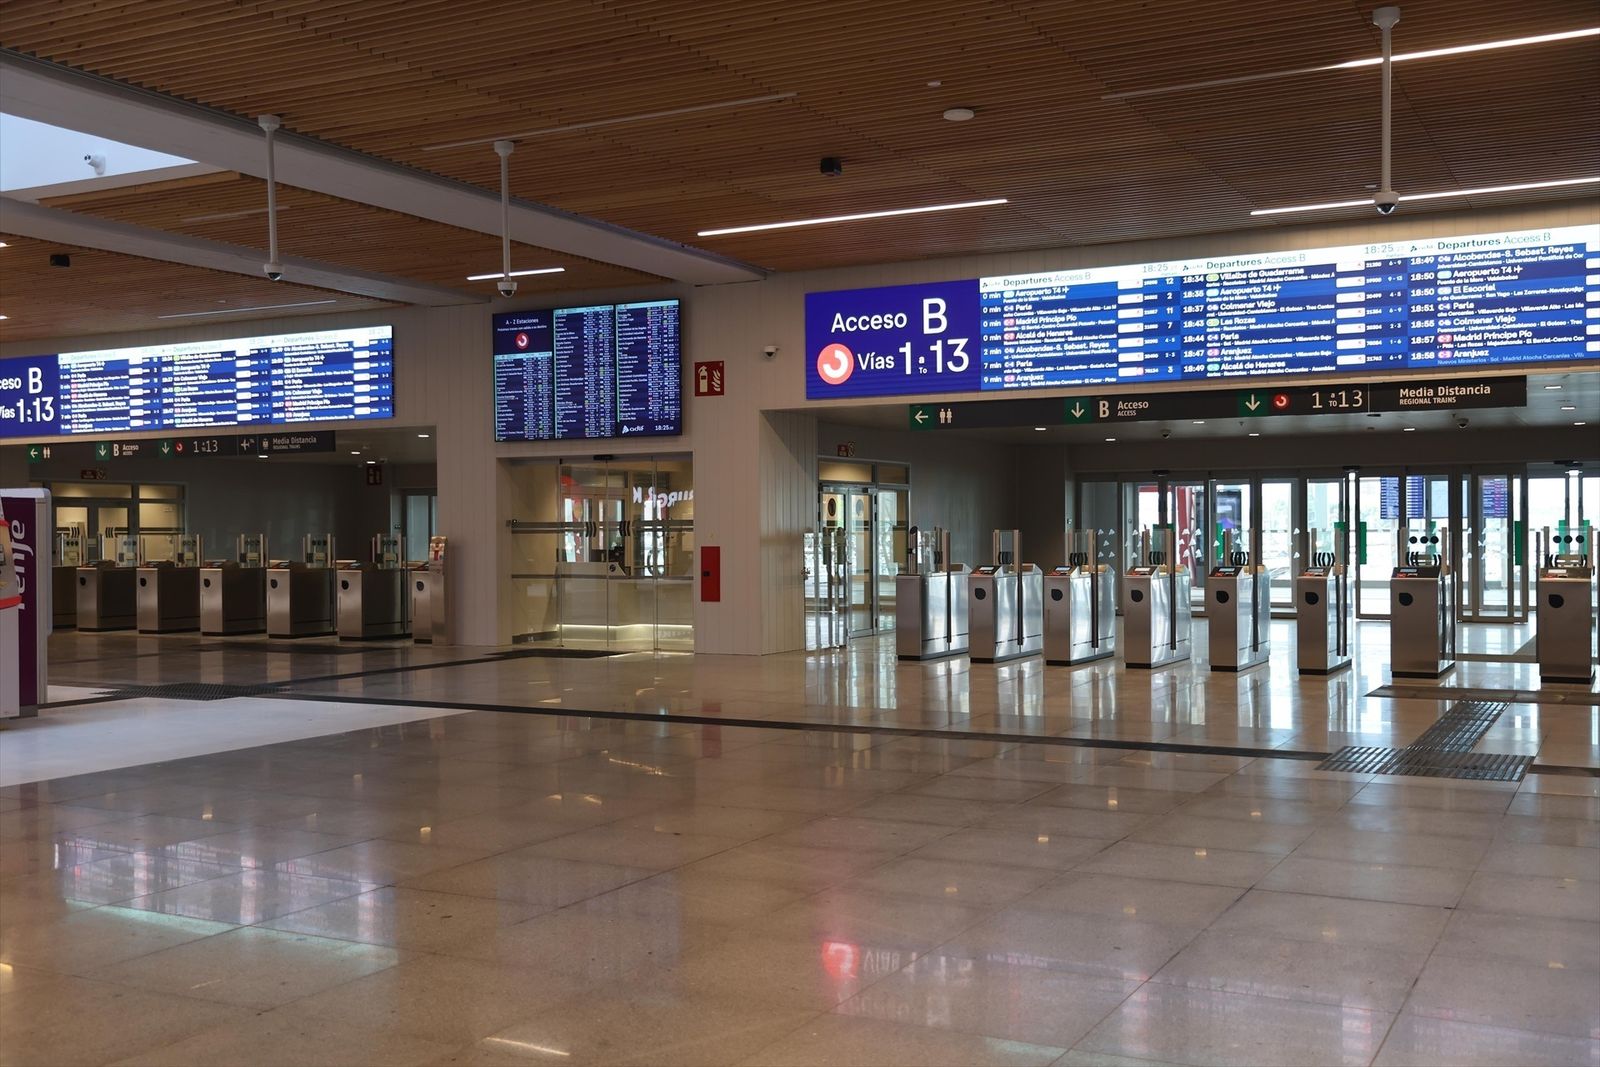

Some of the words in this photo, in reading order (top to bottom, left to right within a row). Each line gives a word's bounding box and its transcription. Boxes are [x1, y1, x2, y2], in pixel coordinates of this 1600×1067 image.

[1437, 237, 1500, 251] Departures
[1504, 233, 1540, 244] Access
[1543, 232, 1550, 241] B
[1206, 257, 1261, 270] Departures
[1264, 254, 1296, 264] Access
[1299, 253, 1305, 261] B
[1364, 244, 1393, 254] 18:25
[1410, 256, 1434, 264] 18:49
[1548, 244, 1573, 255] Reyes
[1003, 275, 1052, 287] Departures
[1054, 273, 1083, 281] Access
[1143, 263, 1168, 272] 18:25
[1182, 275, 1203, 283] 18:34
[1220, 272, 1246, 280] Villalba
[1259, 267, 1303, 277] Guadarrama
[1410, 272, 1434, 280] 18:50
[1453, 266, 1499, 278] Aeropuerto
[1015, 288, 1051, 298] Aeropuerto
[1220, 286, 1260, 296] Aeropuerto
[1410, 288, 1434, 296] 18:50
[1462, 283, 1495, 292] Escorial
[1220, 301, 1255, 310] Colmenar
[1257, 300, 1275, 308] Viejo
[1411, 304, 1434, 312] 18:51
[1453, 301, 1473, 309] Parla
[831, 313, 907, 333] Acceso
[923, 298, 947, 334] B
[1234, 316, 1255, 324] Rozas
[1411, 319, 1434, 328] 18:55
[1453, 316, 1493, 325] Colmenar
[1495, 314, 1515, 324] Viejo
[1220, 332, 1238, 340] Parla
[1411, 335, 1434, 344] 18:57
[1453, 332, 1481, 341] Madrid
[1483, 330, 1517, 341] Príncipe
[1518, 329, 1532, 337] Pío
[858, 352, 894, 370] Vías
[899, 342, 911, 374] 1
[919, 356, 924, 364] a
[930, 338, 969, 373] 13
[1220, 347, 1251, 356] Aranjuez
[1411, 351, 1434, 359] 18:58
[1453, 348, 1488, 358] Aranjuez
[1183, 364, 1204, 372] 18:49
[1220, 362, 1243, 370] Alcalá
[1255, 360, 1285, 368] Henares
[0, 378, 21, 390] eso
[29, 367, 42, 393] B
[1016, 374, 1044, 382] Aranjuez
[1400, 387, 1433, 397] Media
[1438, 384, 1490, 396] Distancia
[1312, 392, 1323, 408] 1
[1339, 390, 1362, 407] 13
[16, 399, 24, 422] 1
[32, 397, 54, 421] 13
[1100, 401, 1109, 418] B
[1118, 401, 1148, 410] Acceso
[114, 444, 119, 456] B
[194, 441, 199, 452] 1
[206, 440, 218, 452] 13
